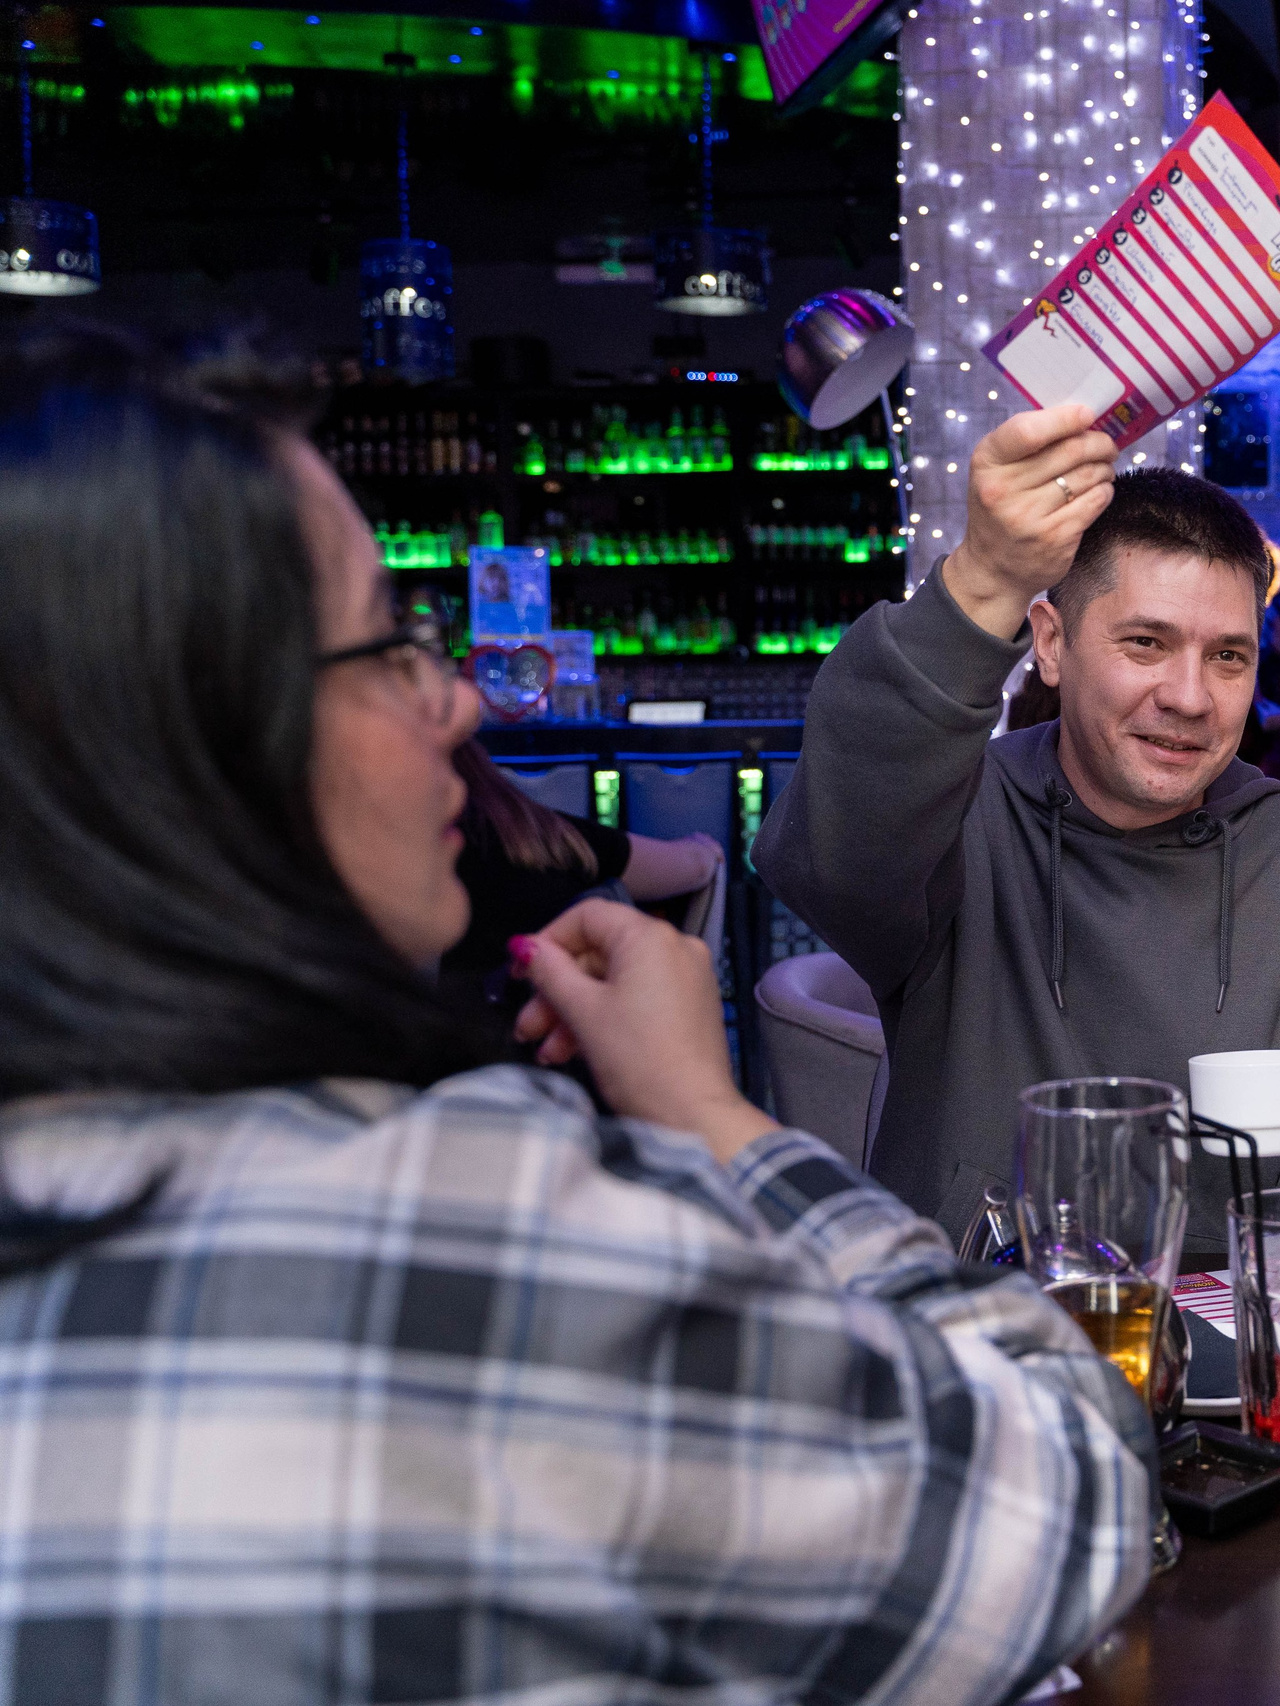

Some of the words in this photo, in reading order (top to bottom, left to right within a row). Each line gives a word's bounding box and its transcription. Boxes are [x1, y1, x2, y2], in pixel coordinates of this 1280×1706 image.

[1168, 169, 1181, 182] 1
[1149, 189, 1164, 203] 2
[1131, 208, 1146, 223] 3
[1114, 229, 1128, 243] 4
[1096, 248, 1110, 262] 5
[1077, 269, 1091, 283] 6
[1058, 288, 1073, 303] 7
